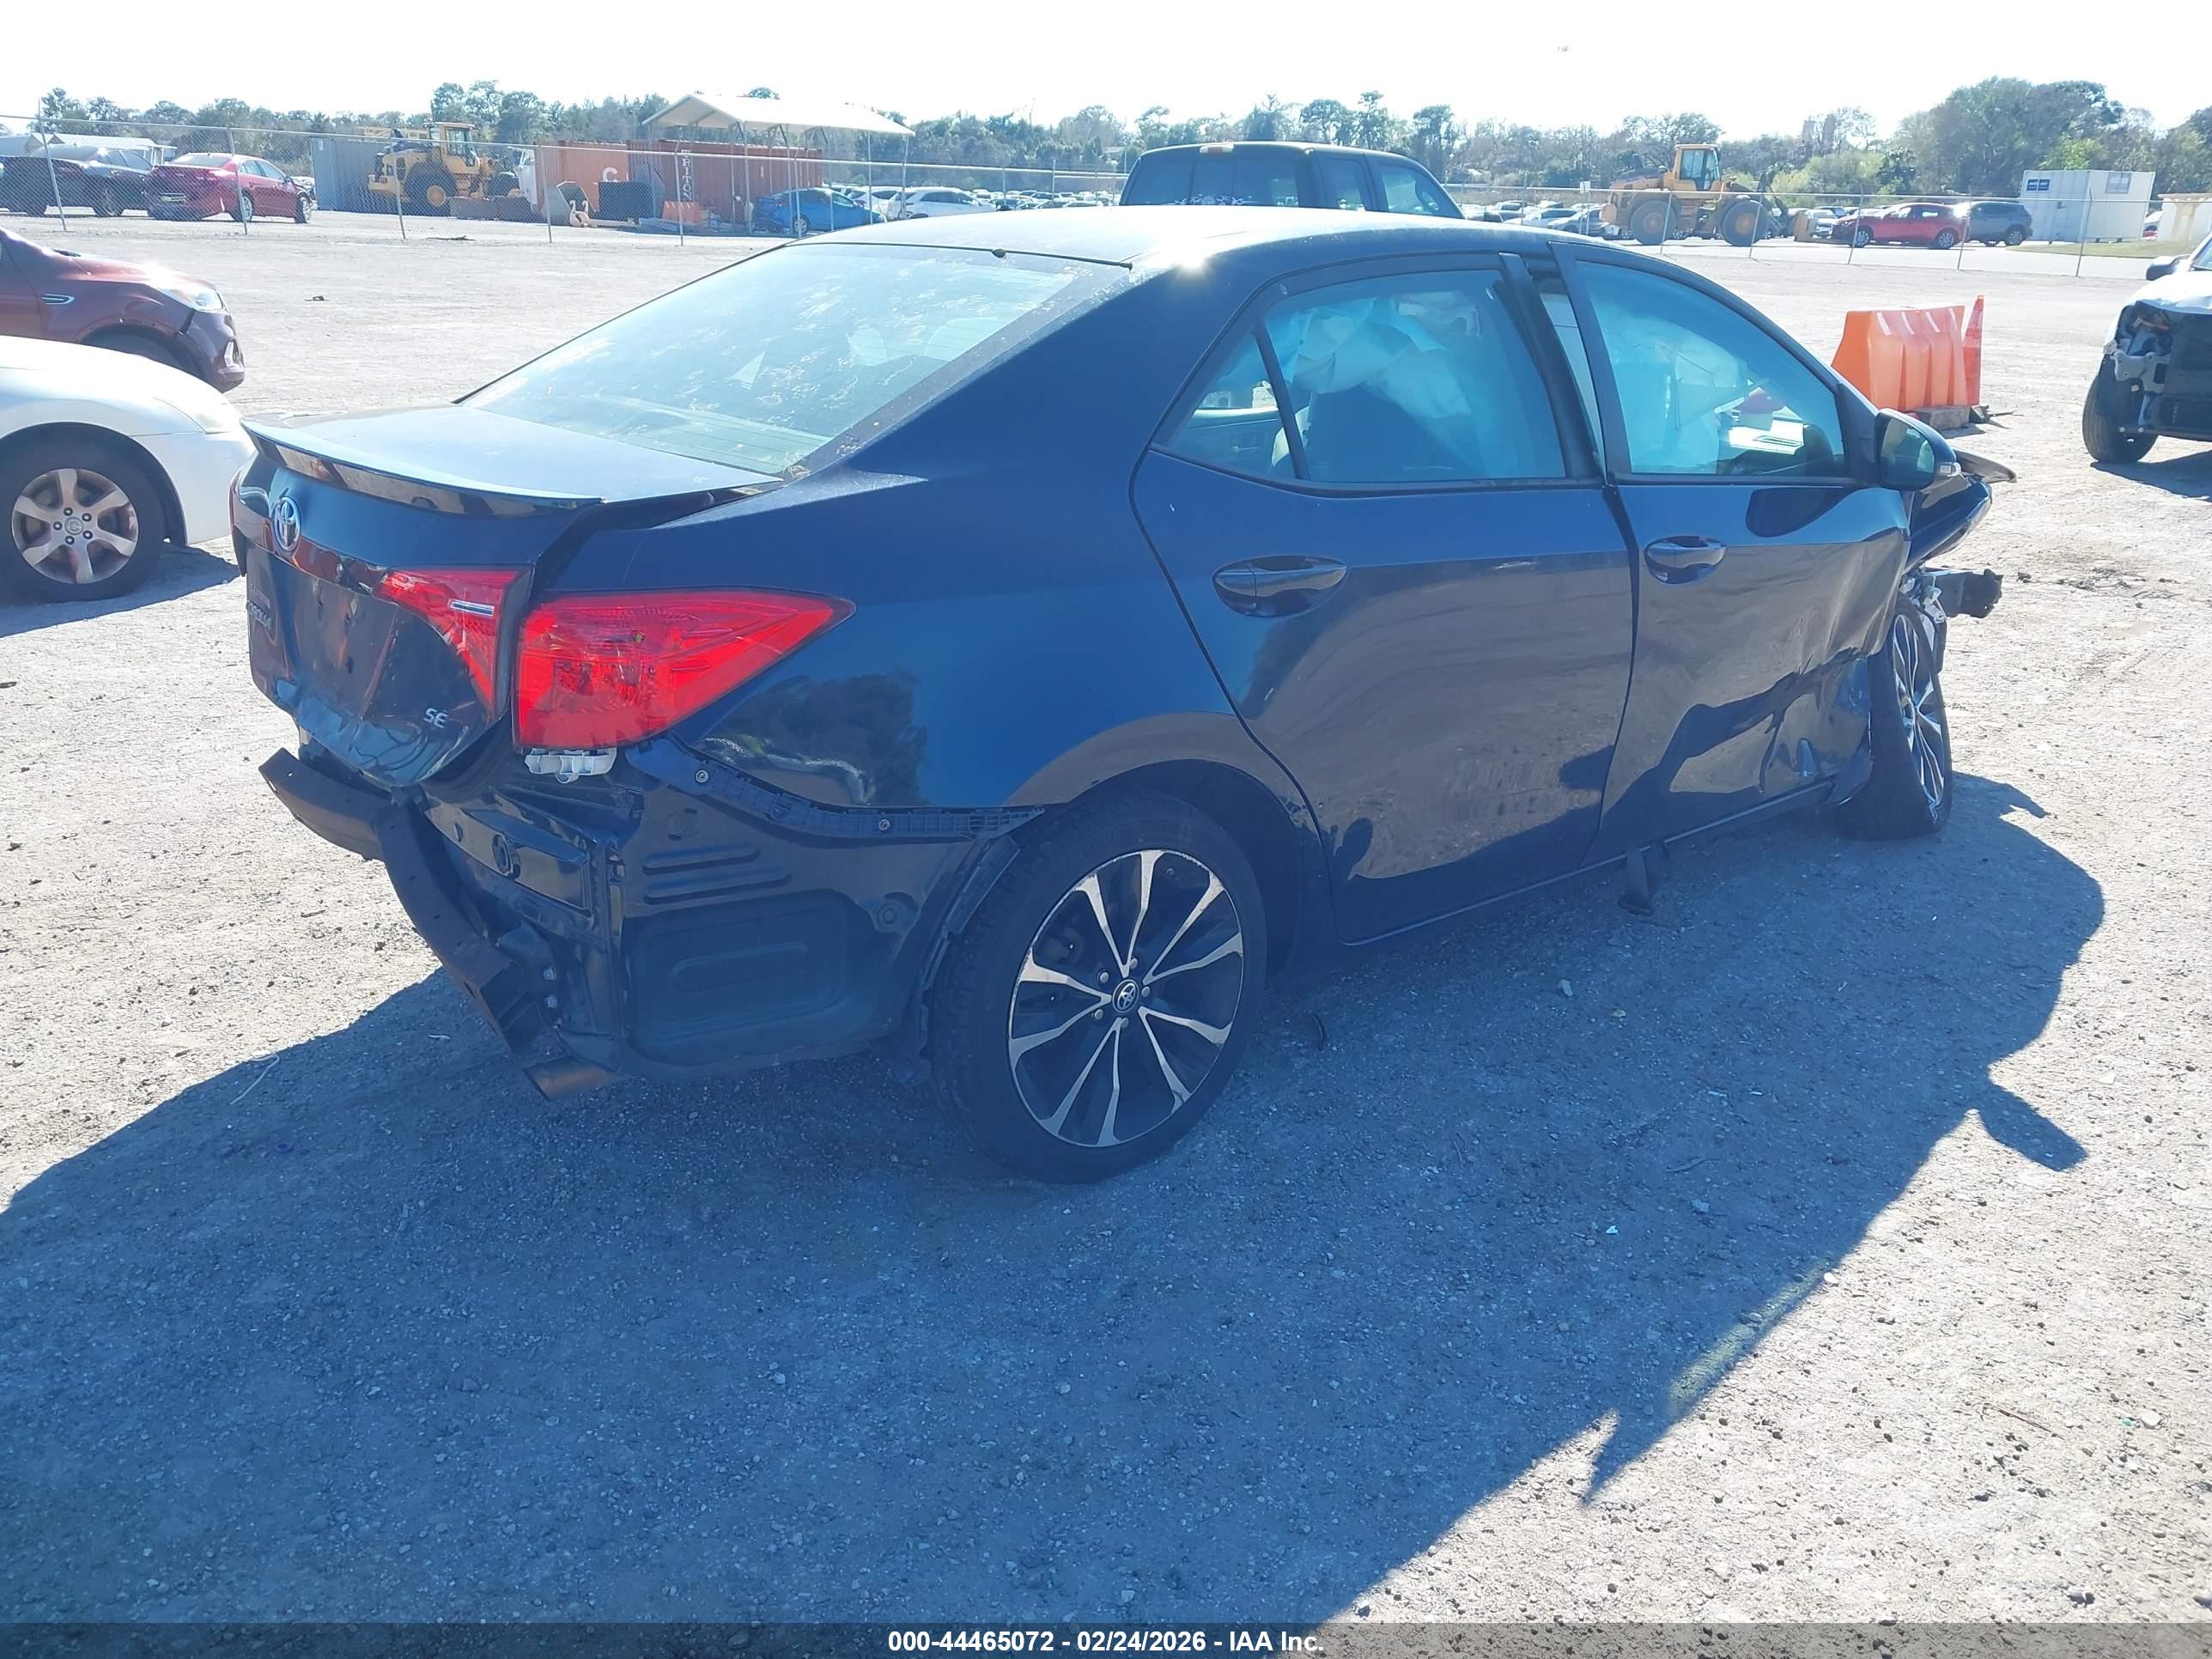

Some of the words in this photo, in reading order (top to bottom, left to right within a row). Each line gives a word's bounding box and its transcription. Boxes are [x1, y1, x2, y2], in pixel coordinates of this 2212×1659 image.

[681, 149, 692, 201] TRITON
[246, 601, 271, 629] OROLLA
[422, 708, 449, 729] SE
